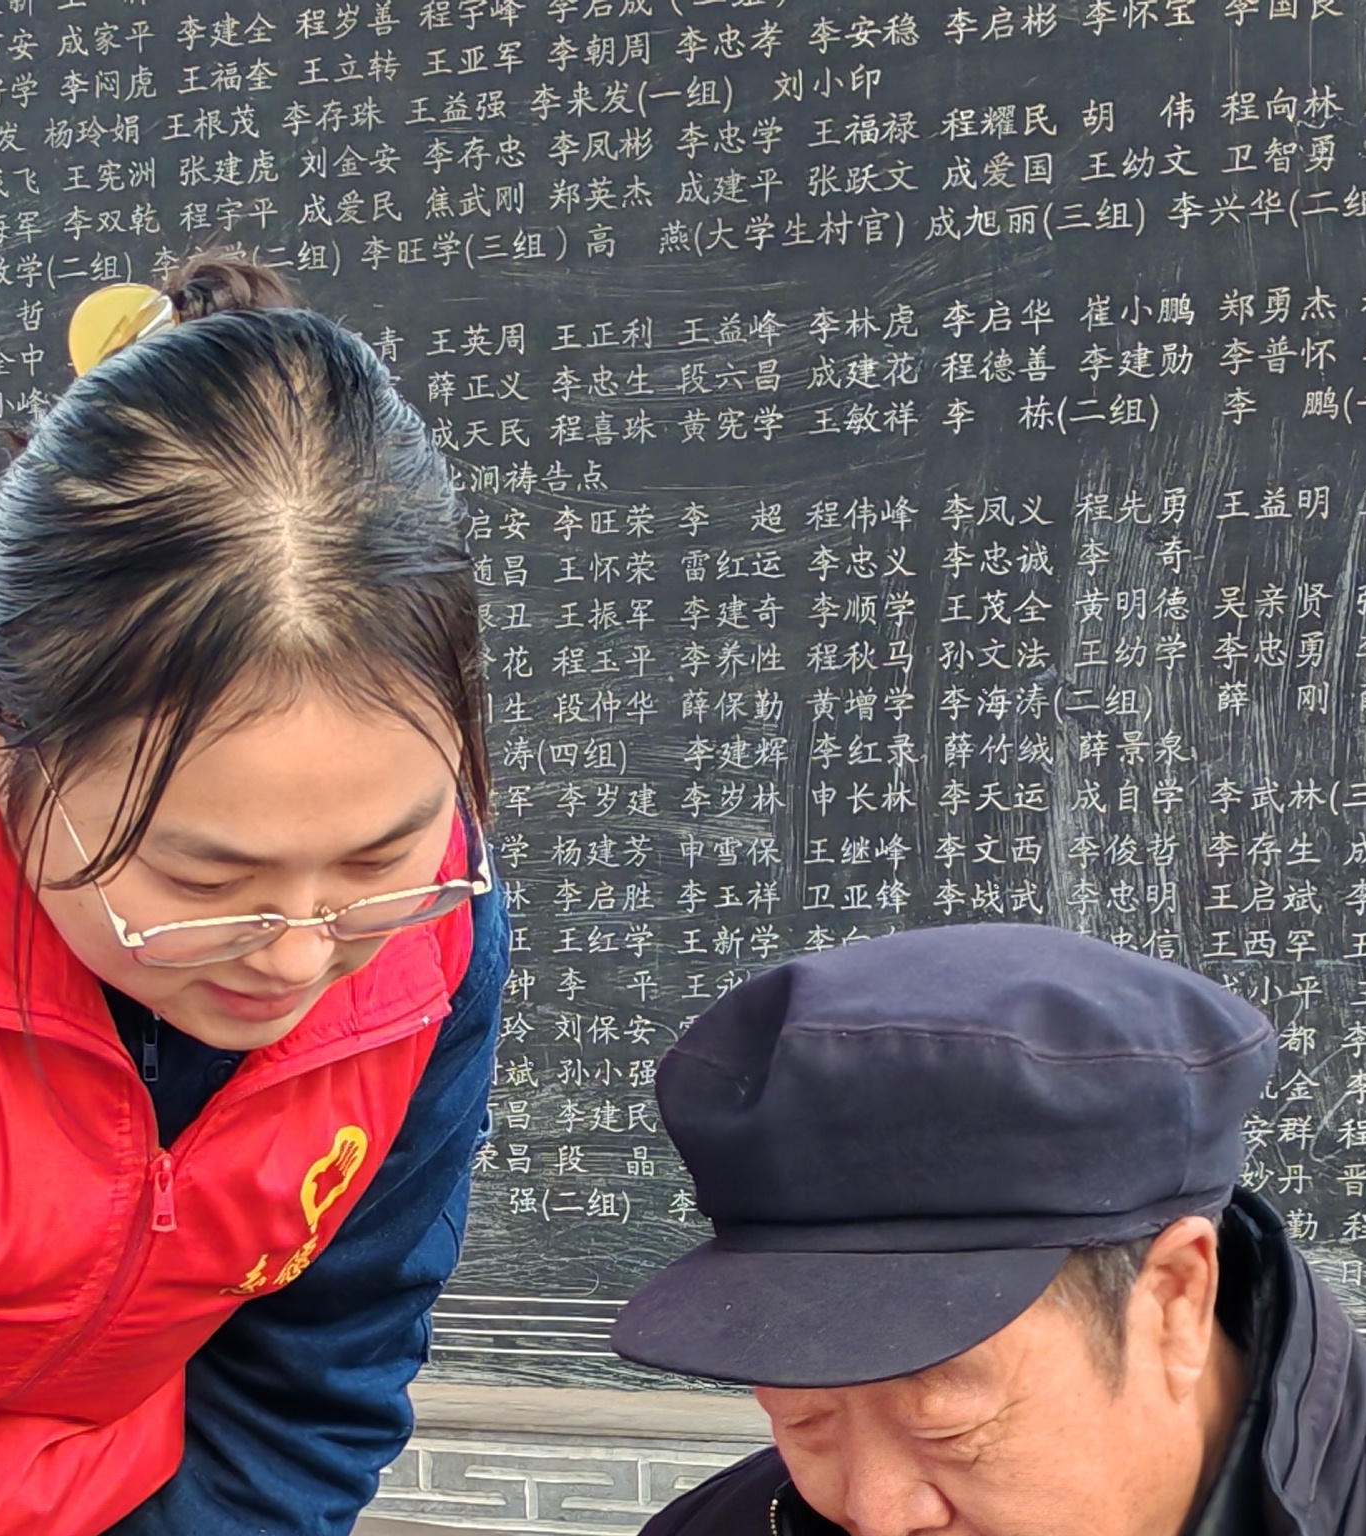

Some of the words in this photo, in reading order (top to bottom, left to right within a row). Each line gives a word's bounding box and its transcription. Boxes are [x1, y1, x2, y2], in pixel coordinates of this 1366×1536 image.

[57, 20, 154, 58] 成家平
[177, 12, 276, 52] 李建全
[295, 2, 400, 40] 程岁善
[177, 59, 277, 94] 王福奎
[298, 49, 401, 86] 王立转
[422, 41, 524, 77] 王亚军
[548, 32, 651, 72] 李朝周
[676, 20, 782, 62] 李忠孝
[807, 14, 920, 55] 李安稳
[44, 113, 141, 148] 杨玲娟
[162, 104, 259, 141] 王根茂
[281, 100, 384, 136] 李存珠
[404, 92, 508, 126] 王益强
[773, 63, 882, 101] 刘小印
[63, 157, 156, 192] 王宪洲
[180, 148, 279, 187] 张建虎
[299, 143, 402, 178] 刘金安
[422, 134, 525, 174] 李存忠
[676, 117, 782, 160] 李忠学
[807, 109, 920, 148] 王福禄
[1220, 87, 1344, 126] 程向林
[180, 197, 278, 234] 程宇平
[298, 188, 403, 227] 成爱民
[425, 182, 524, 218] 焦武刚
[549, 174, 653, 213] 郑英杰
[676, 168, 783, 207] 成建平
[807, 159, 918, 196] 张跃文
[942, 149, 1054, 191] 成爱国
[1081, 144, 1198, 181] 王幼文
[1221, 133, 1337, 176] 卫智勇
[426, 323, 525, 358] 王英周
[551, 316, 653, 352] 王正利
[680, 309, 788, 348] 王益峰
[808, 304, 919, 343] 李林虎
[942, 298, 1055, 340] 李启华
[1081, 294, 1195, 332] 崔小鹏
[1220, 286, 1337, 327] 郑勇杰
[428, 370, 530, 406] 薛正义
[551, 363, 655, 401] 李忠生
[678, 359, 781, 395] 段六昌
[807, 352, 919, 391] 成建花
[940, 345, 1056, 384] 程德善
[1220, 335, 1337, 376] 李普怀
[550, 413, 657, 445] 程喜珠
[679, 404, 784, 443] 黄宪学
[810, 400, 919, 437] 王敏祥
[554, 503, 655, 542] 李旺荣
[806, 497, 919, 535] 程伟峰
[941, 492, 1054, 531] 李凤义
[1216, 485, 1331, 521] 王益明
[554, 552, 656, 586] 王怀荣
[682, 549, 785, 583] 雷红运
[808, 544, 915, 582] 李忠义
[940, 542, 1054, 579] 李忠诚
[555, 598, 655, 631] 王振军
[680, 594, 784, 631] 李建奇
[808, 590, 915, 629] 李顺学
[940, 588, 1053, 626] 王茂全
[1076, 585, 1190, 624] 黄明德
[1213, 581, 1333, 620] 吴亲贤
[552, 643, 656, 679] 程玉平
[807, 640, 913, 675] 程秋马
[940, 638, 1051, 671] 孙文法
[1074, 634, 1187, 671] 王幼学
[1212, 631, 1326, 671] 李忠勇
[557, 690, 659, 725] 段仲华
[682, 687, 783, 725] 薛保勤
[807, 687, 914, 724] 黄增学
[684, 736, 789, 772] 李建辉
[556, 782, 659, 818] 李岁建
[680, 781, 785, 818] 李岁林
[810, 784, 915, 817] 申长林
[938, 781, 1047, 815] 李天运
[1074, 780, 1184, 814] 成自学
[552, 835, 654, 867] 杨建芳
[806, 836, 911, 871] 王继峰
[934, 832, 1042, 869] 李文西
[1068, 832, 1180, 869] 李俊哲
[1206, 832, 1321, 868] 李存生
[553, 882, 655, 914] 李启胜
[677, 883, 780, 914] 李玉祥
[803, 881, 911, 914] 卫亚锋
[934, 881, 1044, 915] 李战武
[1067, 881, 1177, 916] 李忠明
[1205, 881, 1322, 915] 王启斌
[553, 924, 654, 958] 王红学
[678, 924, 780, 958] 王新学
[555, 1012, 656, 1045] 刘保安
[556, 1101, 658, 1134] 李建民
